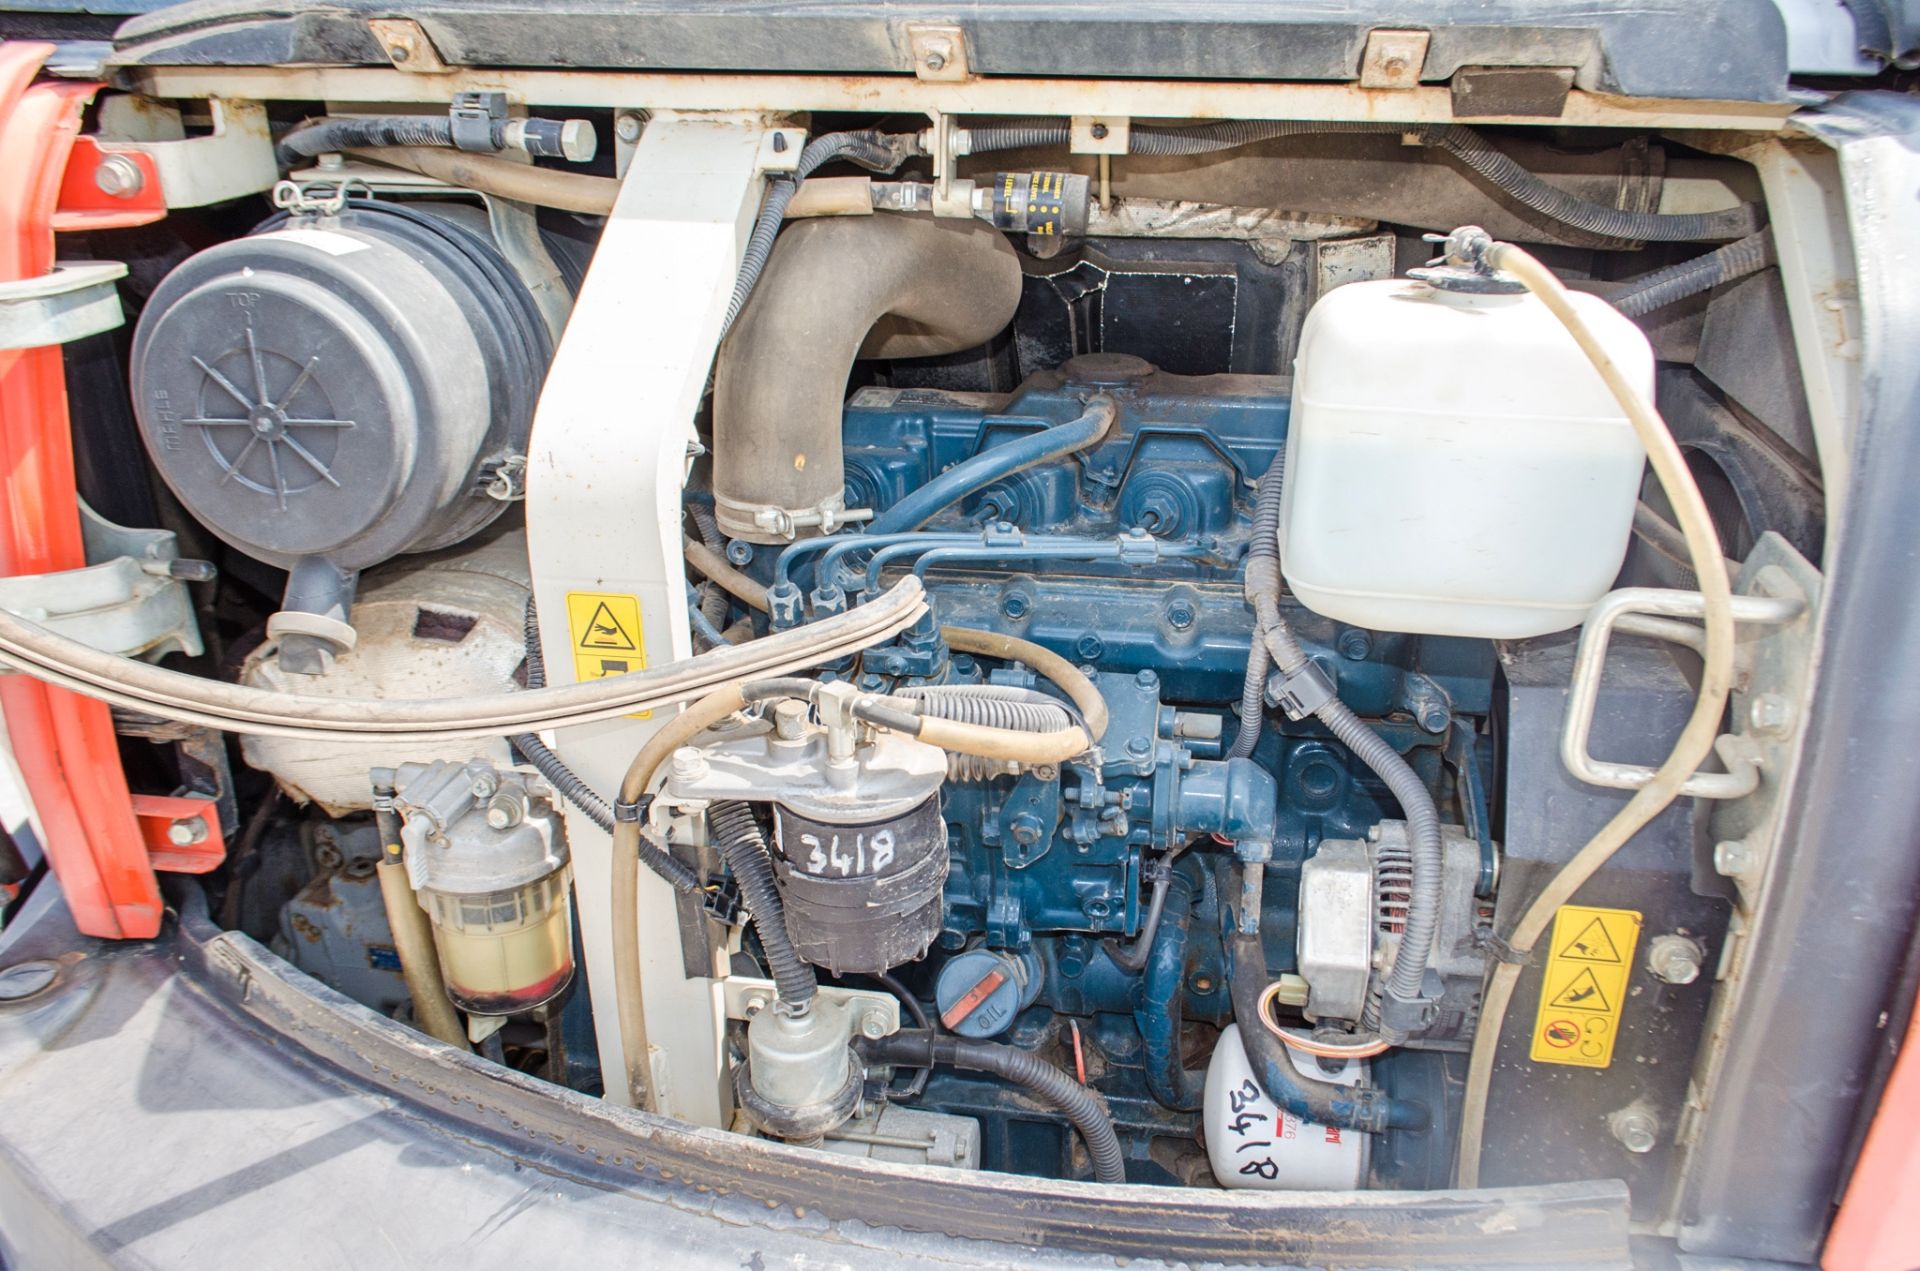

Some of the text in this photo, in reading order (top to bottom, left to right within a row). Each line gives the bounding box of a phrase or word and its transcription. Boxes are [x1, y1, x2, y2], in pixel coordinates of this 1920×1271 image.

[225, 291, 261, 307] TOP
[801, 829, 896, 876] 3418
[977, 1005, 1007, 1029] OIL
[1228, 1078, 1279, 1180] 3418
